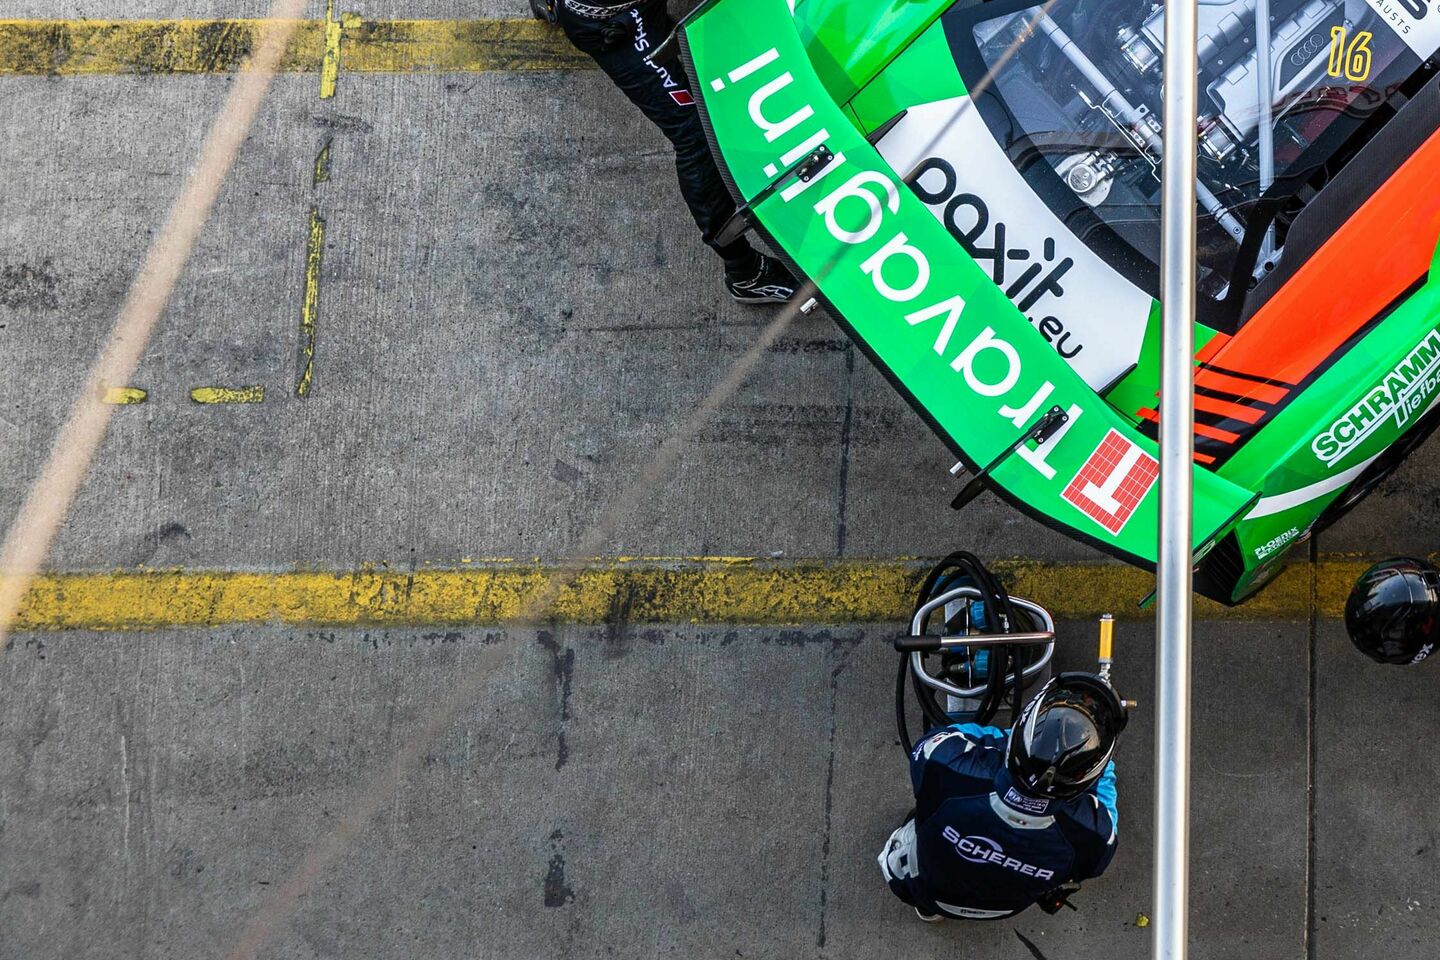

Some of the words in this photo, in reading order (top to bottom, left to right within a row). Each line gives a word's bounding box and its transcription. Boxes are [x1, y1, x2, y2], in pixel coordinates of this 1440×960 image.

[1327, 25, 1373, 83] 16
[708, 46, 1086, 483] Travaglini
[941, 824, 1055, 882] SCHERER
